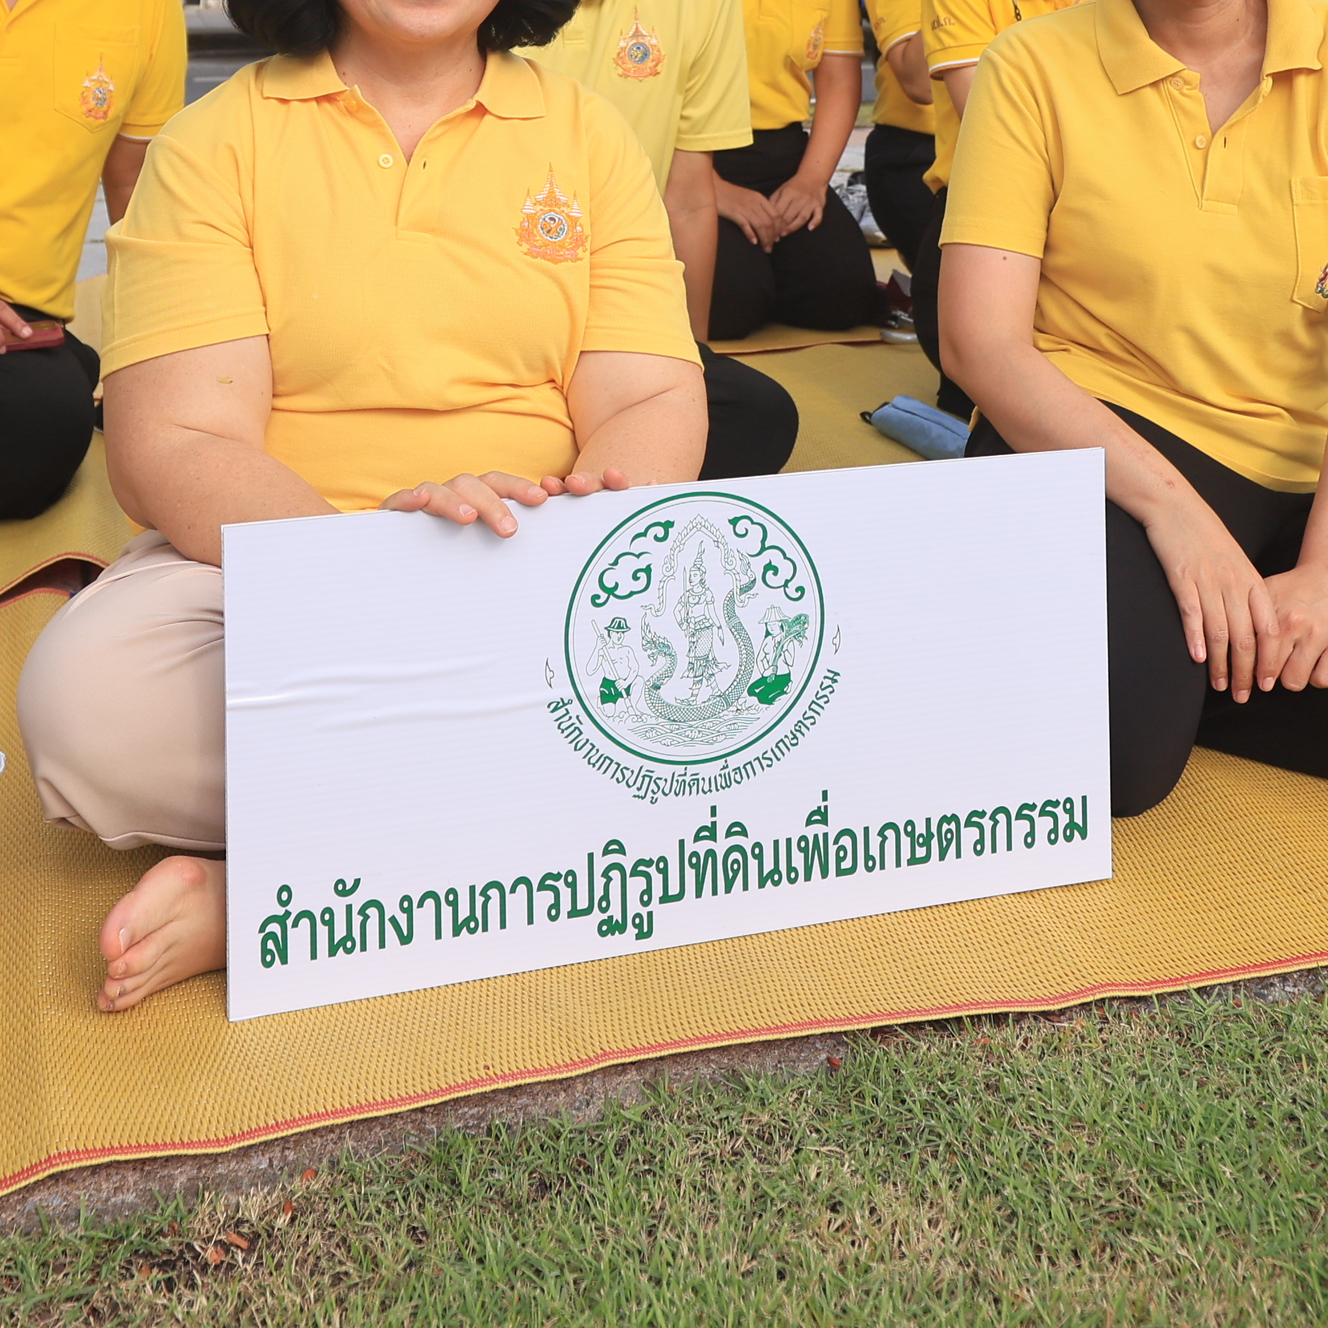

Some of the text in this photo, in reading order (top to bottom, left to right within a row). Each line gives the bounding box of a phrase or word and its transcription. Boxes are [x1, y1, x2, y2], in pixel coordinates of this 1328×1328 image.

[546, 668, 842, 805] สำนักงานการปฏิรูปที่ดินเพื่อการเกษตรกรรม
[258, 790, 1089, 969] สำนักงานการปฏิรูปที่ดินเพื่อเกษตรกรรม
